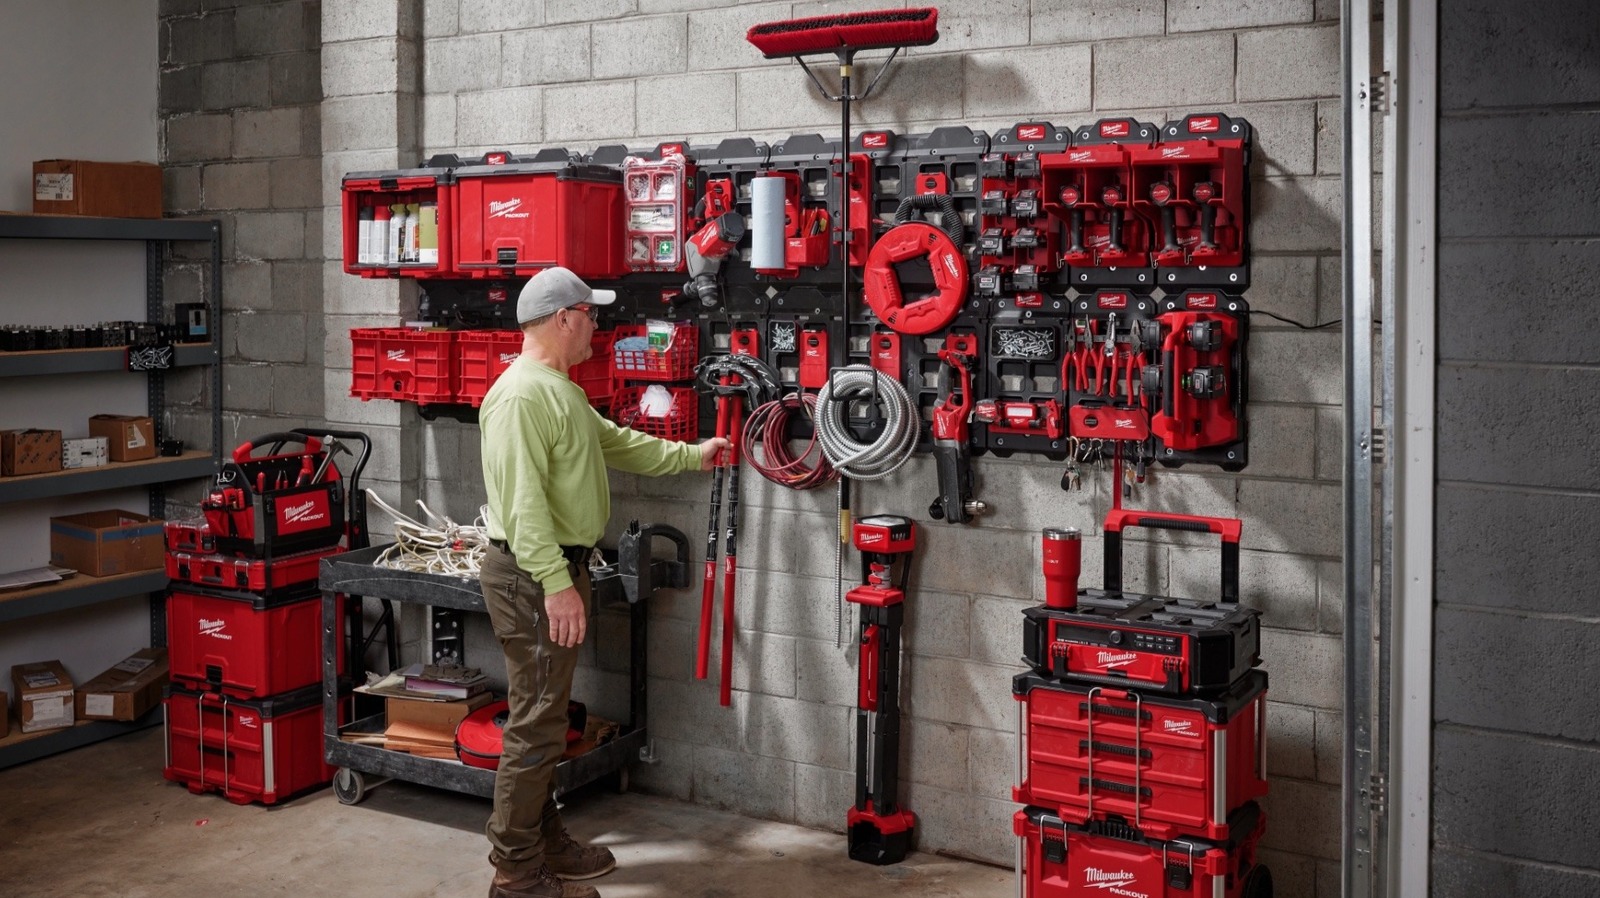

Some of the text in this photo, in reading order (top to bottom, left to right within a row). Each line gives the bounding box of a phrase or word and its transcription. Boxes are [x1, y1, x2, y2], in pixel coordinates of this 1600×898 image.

[489, 197, 521, 214] Milwaukee
[1096, 651, 1137, 663] Milwaukee
[1083, 867, 1134, 882] Milwaukee
[1109, 887, 1149, 898] PACKOUT
